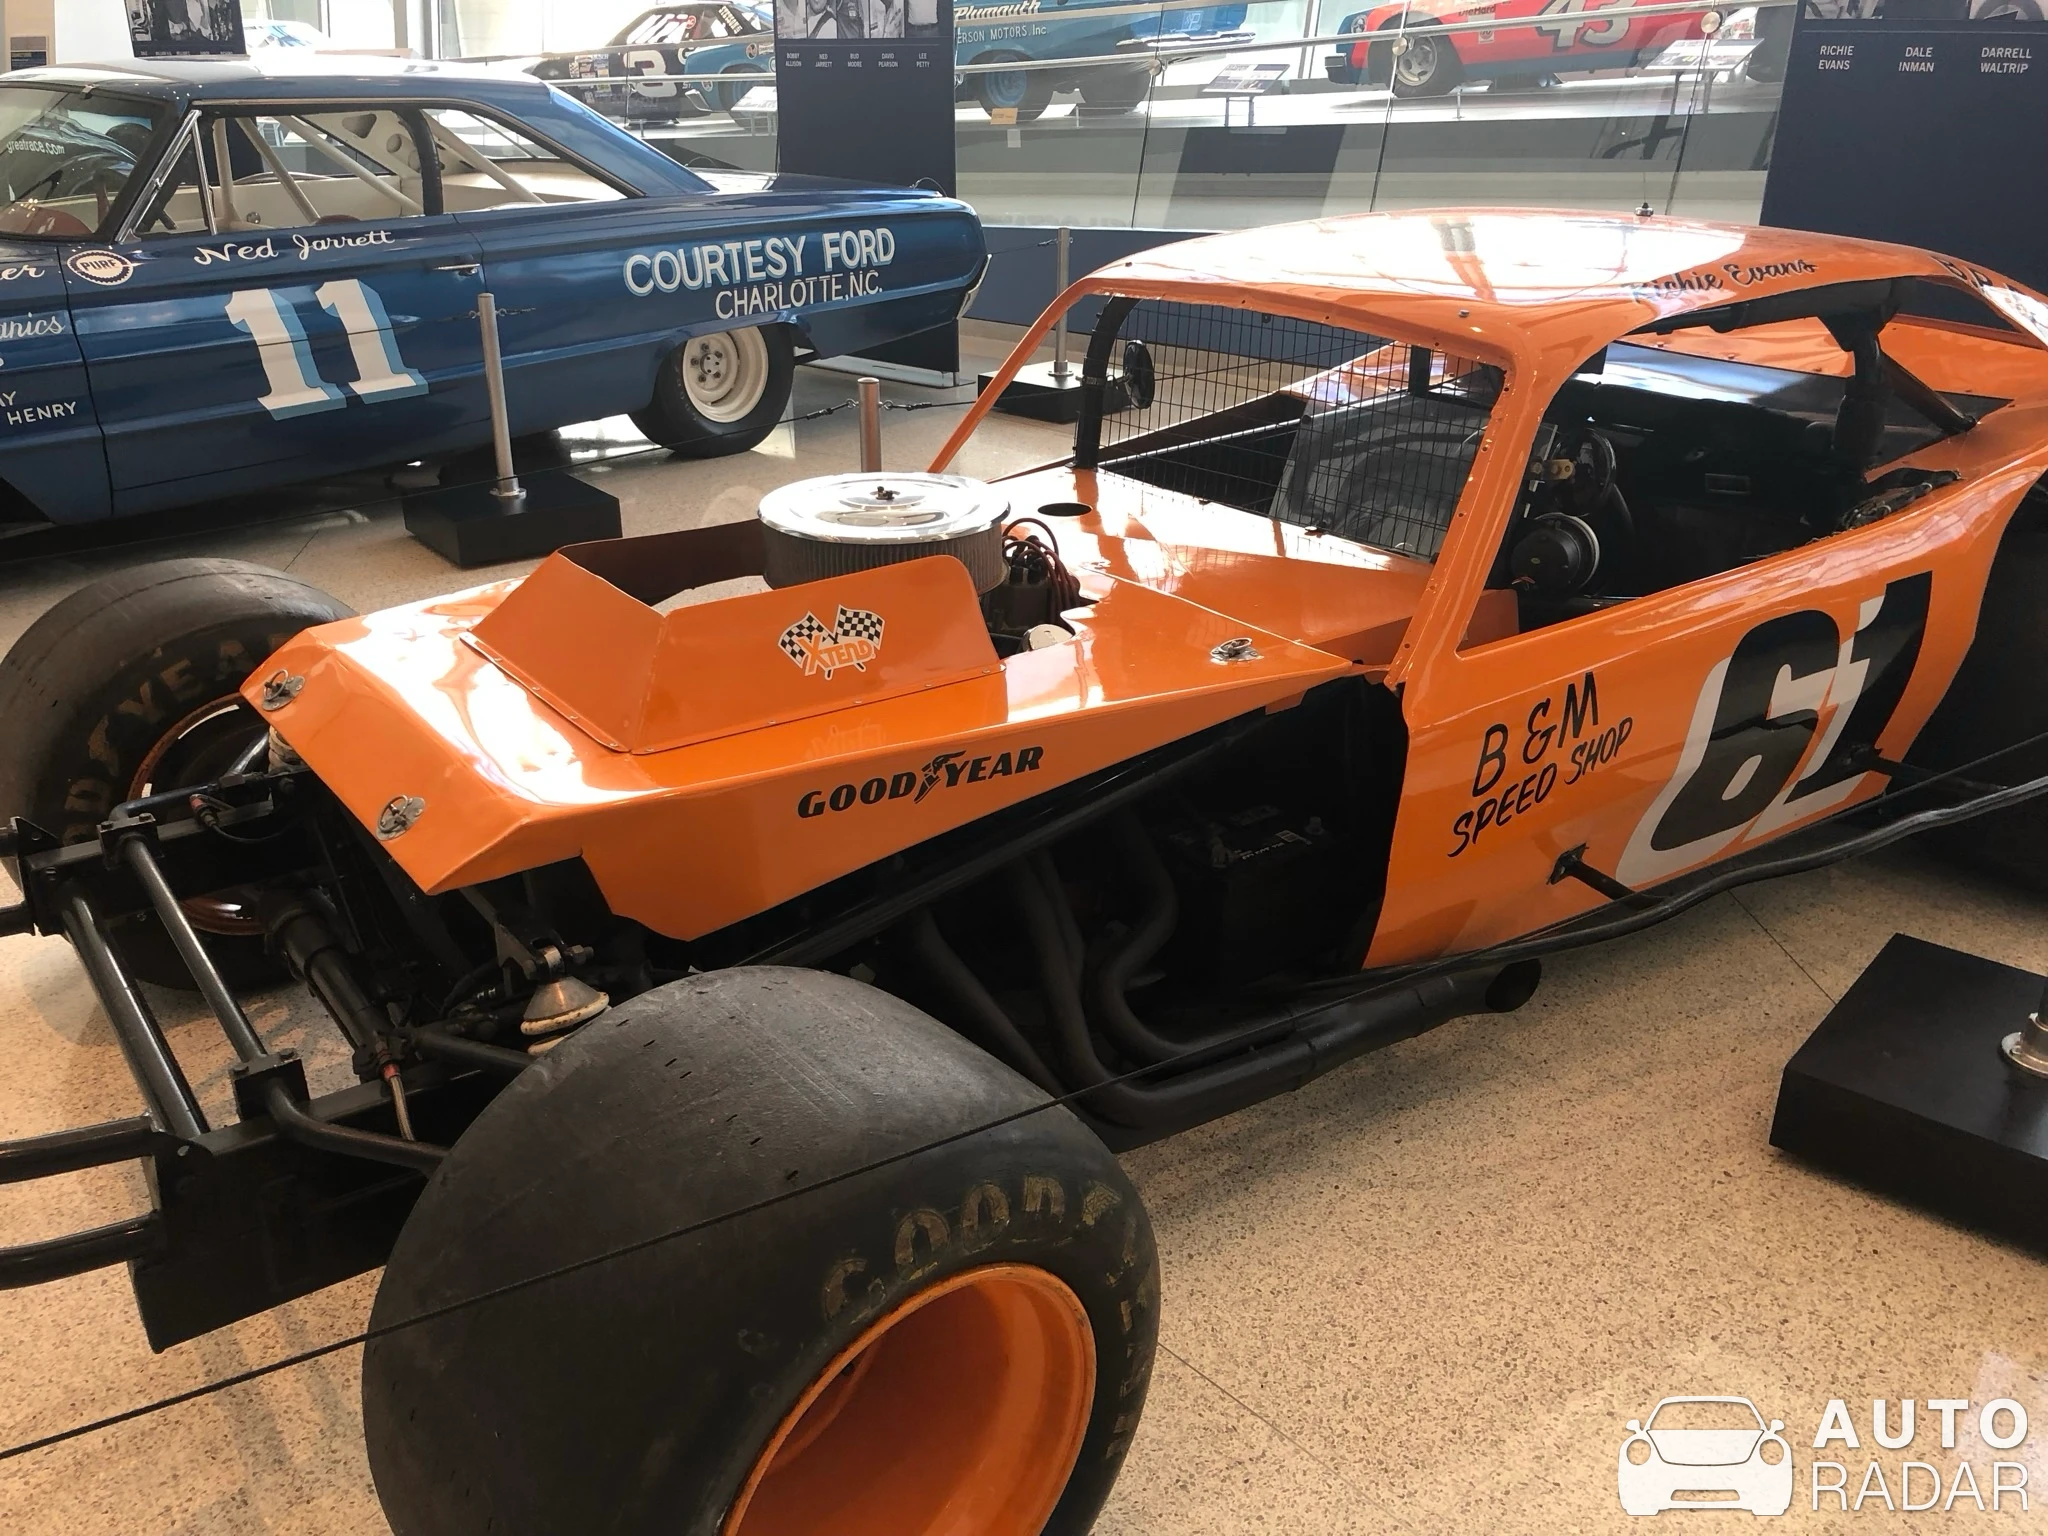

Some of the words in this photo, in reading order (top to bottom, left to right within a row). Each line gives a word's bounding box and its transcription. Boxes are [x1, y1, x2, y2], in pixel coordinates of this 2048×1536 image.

[954, 0, 1041, 20] Plymouth
[1819, 45, 1854, 56] RICHIE
[1905, 47, 1933, 58] DALE
[1981, 47, 2032, 59] DARRELL
[623, 50, 677, 97] 3
[1818, 59, 1850, 70] EVANS
[1898, 61, 1934, 72] INMAN
[1980, 62, 2028, 74] WALTRIP
[7, 139, 65, 155] greatrace.com
[194, 238, 279, 265] Ned
[292, 230, 395, 260] Jarrett
[624, 235, 806, 297] COURTESY
[822, 227, 896, 272] FORD
[1721, 258, 1819, 288] Evans
[225, 279, 424, 417] 11
[7, 401, 77, 426] HENRY
[1630, 569, 1933, 880] 61
[1472, 723, 1509, 798] B
[1447, 762, 1558, 858] SPEED
[1563, 716, 1633, 786] SHOP
